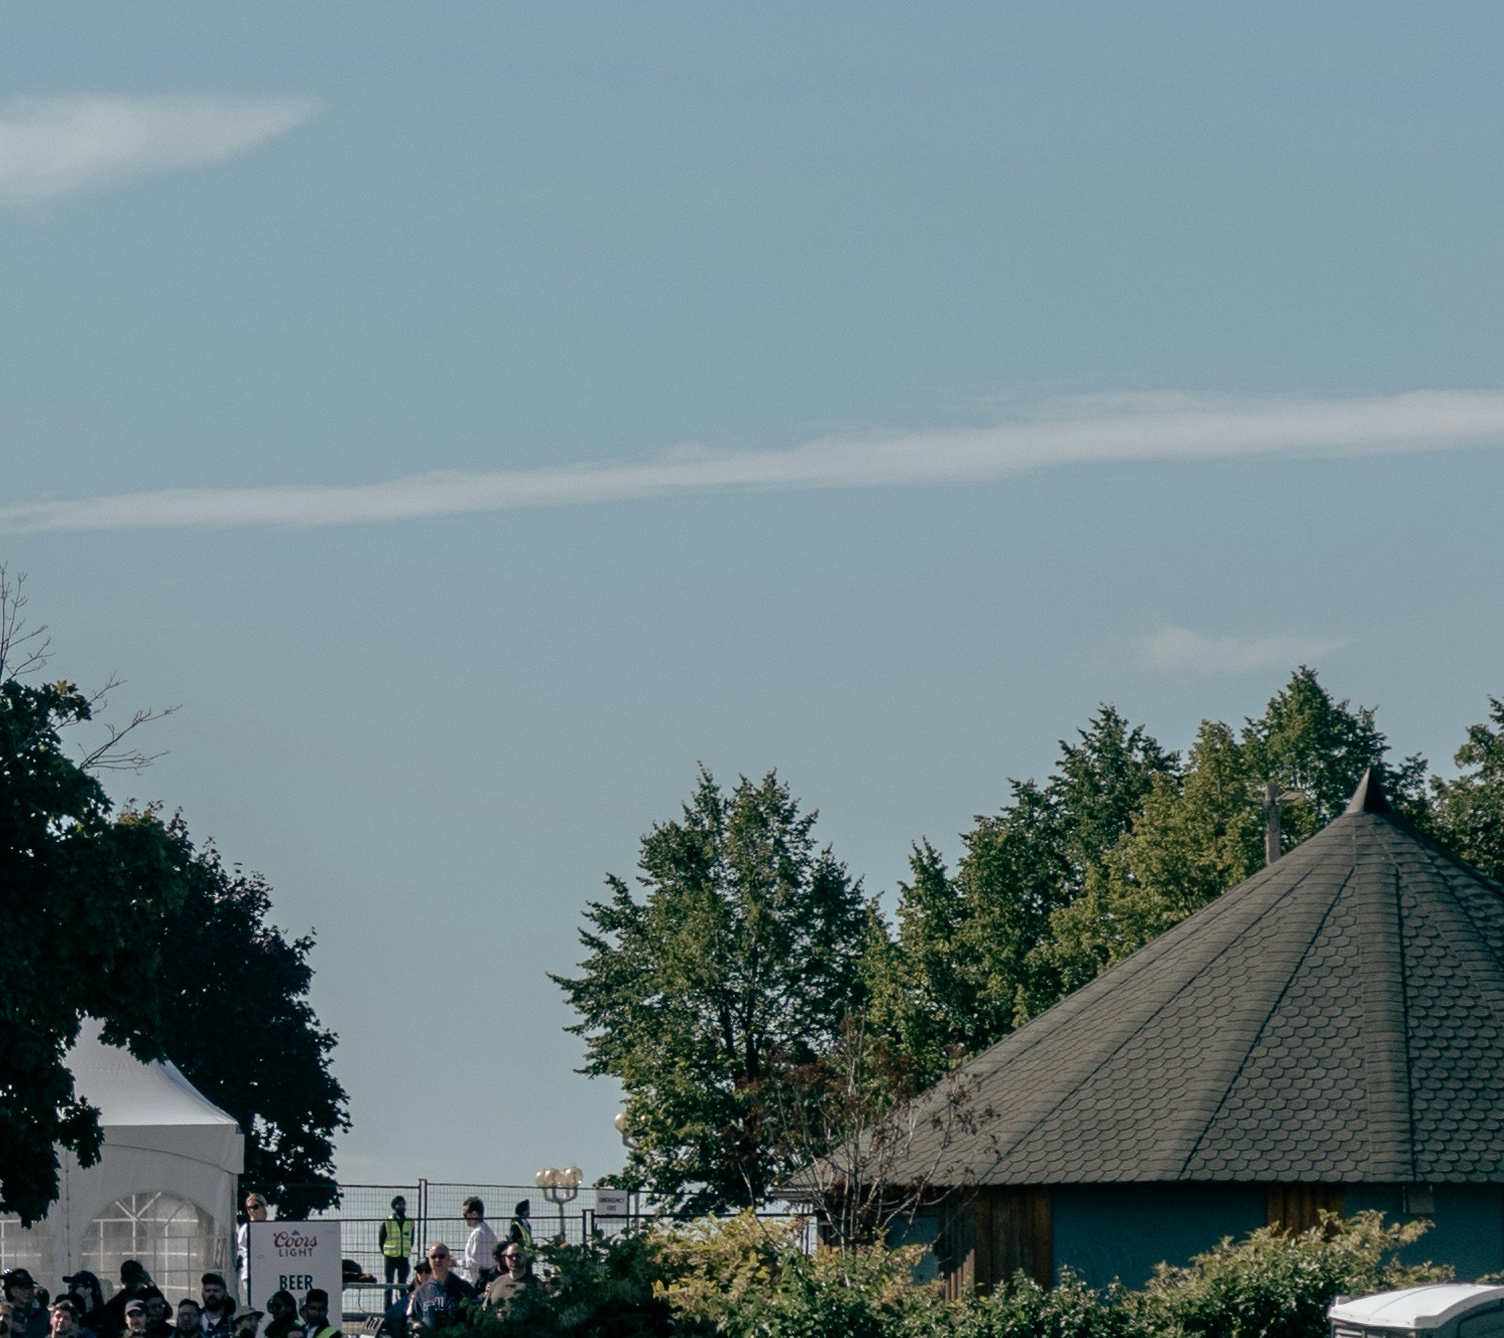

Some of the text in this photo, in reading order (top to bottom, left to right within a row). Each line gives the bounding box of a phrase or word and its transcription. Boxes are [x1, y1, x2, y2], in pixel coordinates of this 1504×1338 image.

[273, 1230, 318, 1248] Coors
[278, 1248, 313, 1258] LIGHT
[279, 1274, 313, 1291] BEER
